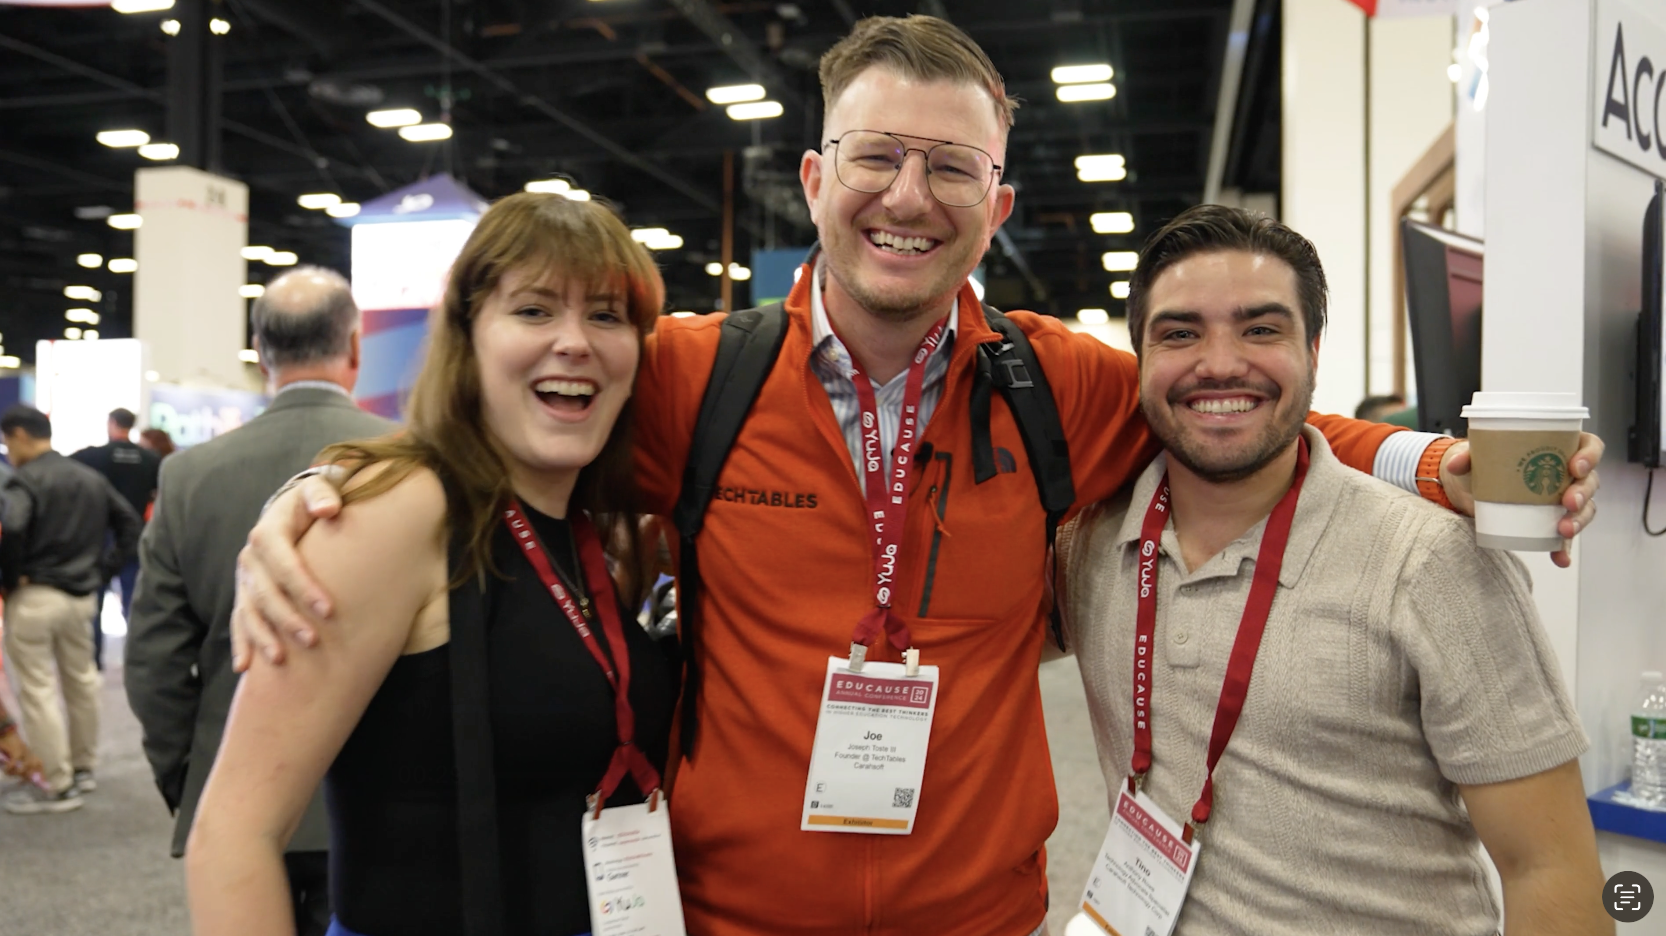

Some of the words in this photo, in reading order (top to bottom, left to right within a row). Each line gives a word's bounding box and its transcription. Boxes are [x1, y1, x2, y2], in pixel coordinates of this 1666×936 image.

[892, 405, 915, 504] EDUCAUSE
[716, 486, 818, 509] ECHTABLES
[836, 680, 909, 695] EDUCAUSE
[1136, 634, 1148, 730] EDUCAUSE
[826, 704, 866, 712] CONNECTING
[899, 708, 929, 716] THINKERS
[889, 714, 927, 722] TECHNOLOGY
[863, 730, 883, 741] Joe
[847, 743, 870, 752] Joseph
[834, 752, 861, 761] Founder
[1123, 801, 1174, 848] EDUCAUSE
[1135, 857, 1151, 877] Tino
